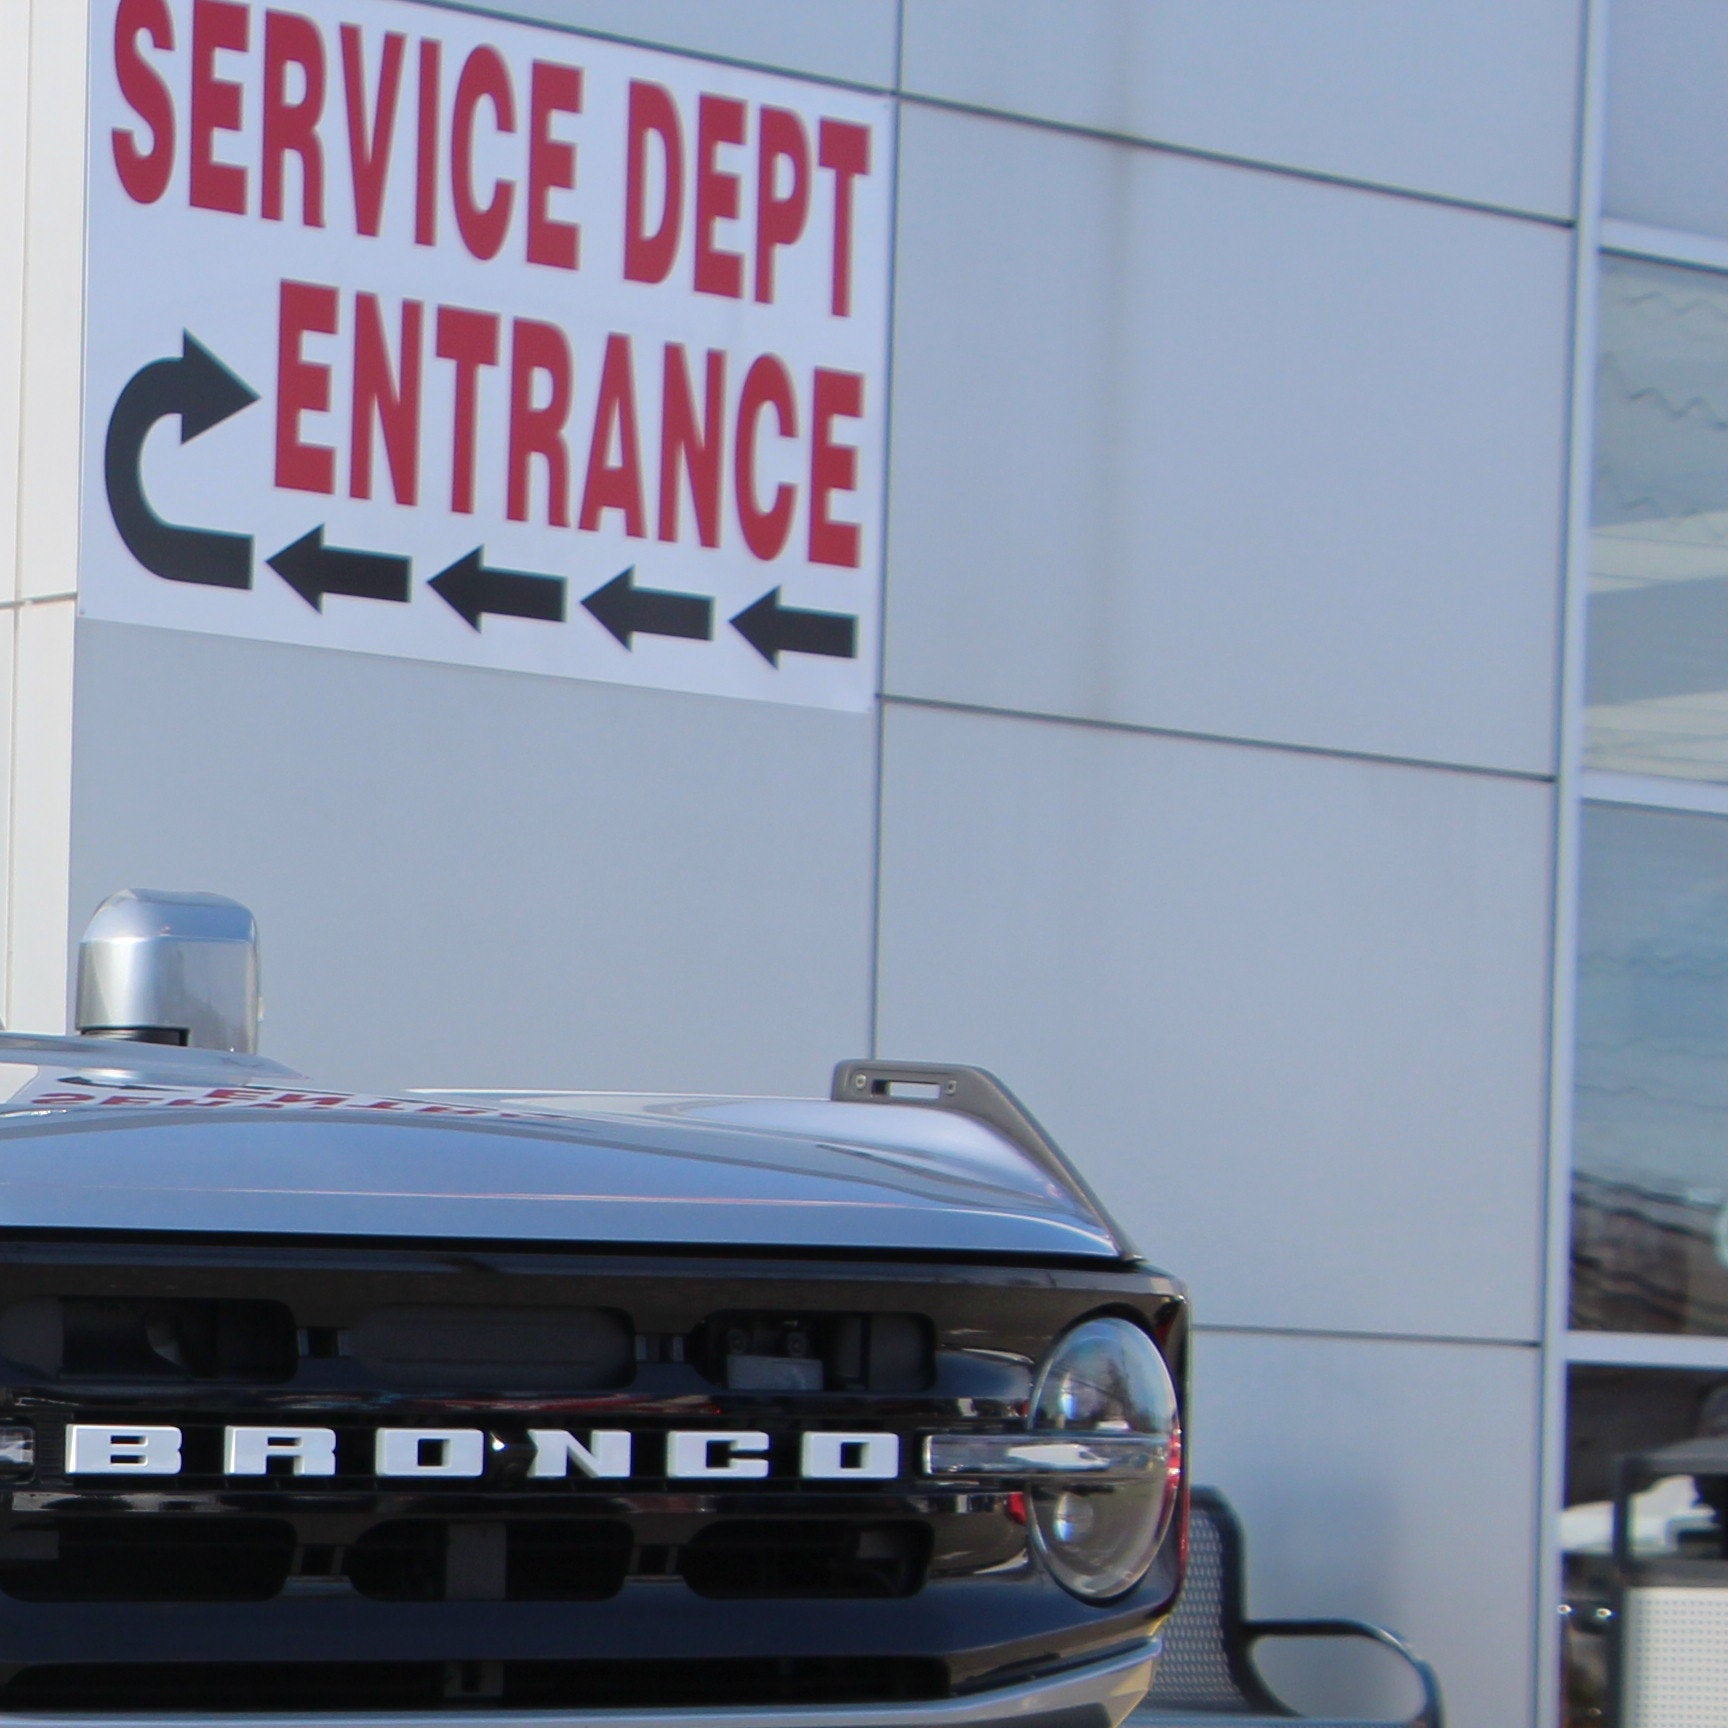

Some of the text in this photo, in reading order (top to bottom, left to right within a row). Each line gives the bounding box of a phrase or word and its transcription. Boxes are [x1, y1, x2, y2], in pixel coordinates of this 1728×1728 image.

[111, 0, 870, 317] SERVICE DEPT
[275, 281, 863, 569] ENTRANCE
[63, 1422, 900, 1479] BRONCO
